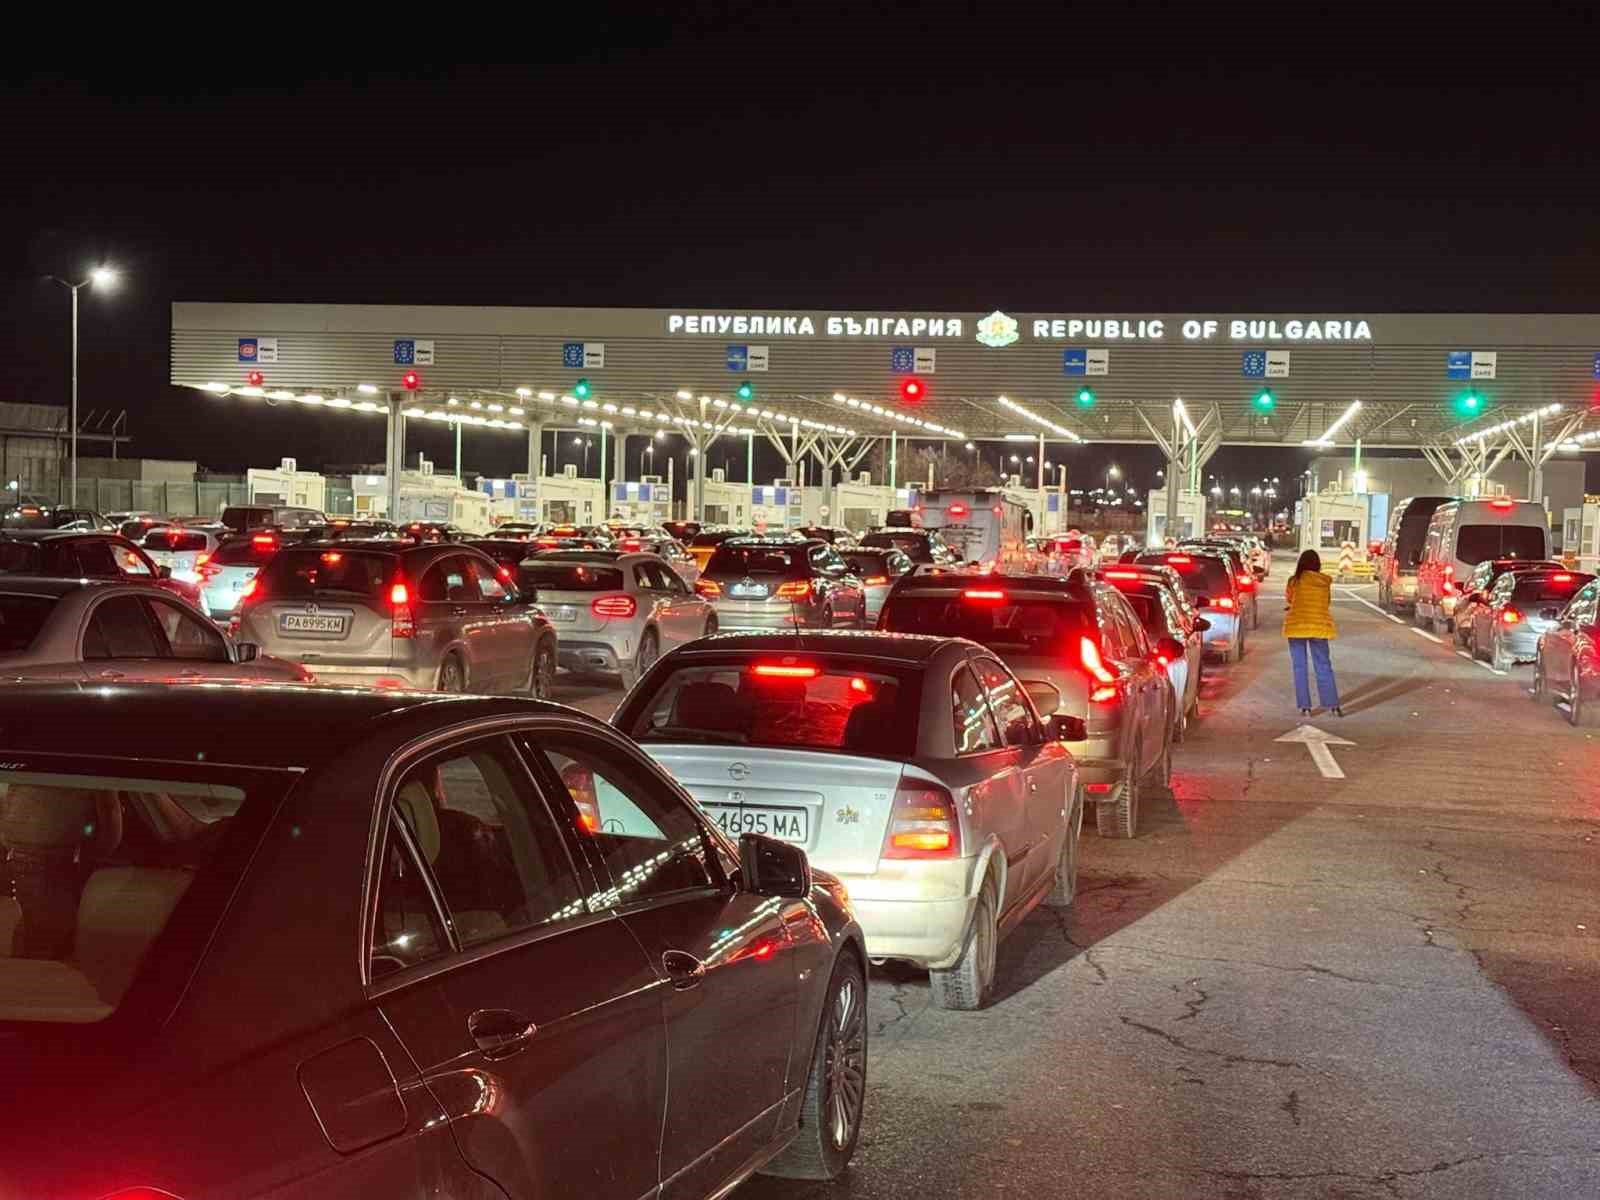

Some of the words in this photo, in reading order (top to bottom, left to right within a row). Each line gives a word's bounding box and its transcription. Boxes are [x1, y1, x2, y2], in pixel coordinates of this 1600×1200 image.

[669, 315, 815, 335] РЕПУБЛИКА
[827, 317, 962, 337] БЪЛГАРИЯ
[1033, 319, 1164, 339] REPUBLIC
[1183, 320, 1218, 339] OF
[1230, 320, 1372, 340] BULGARIA
